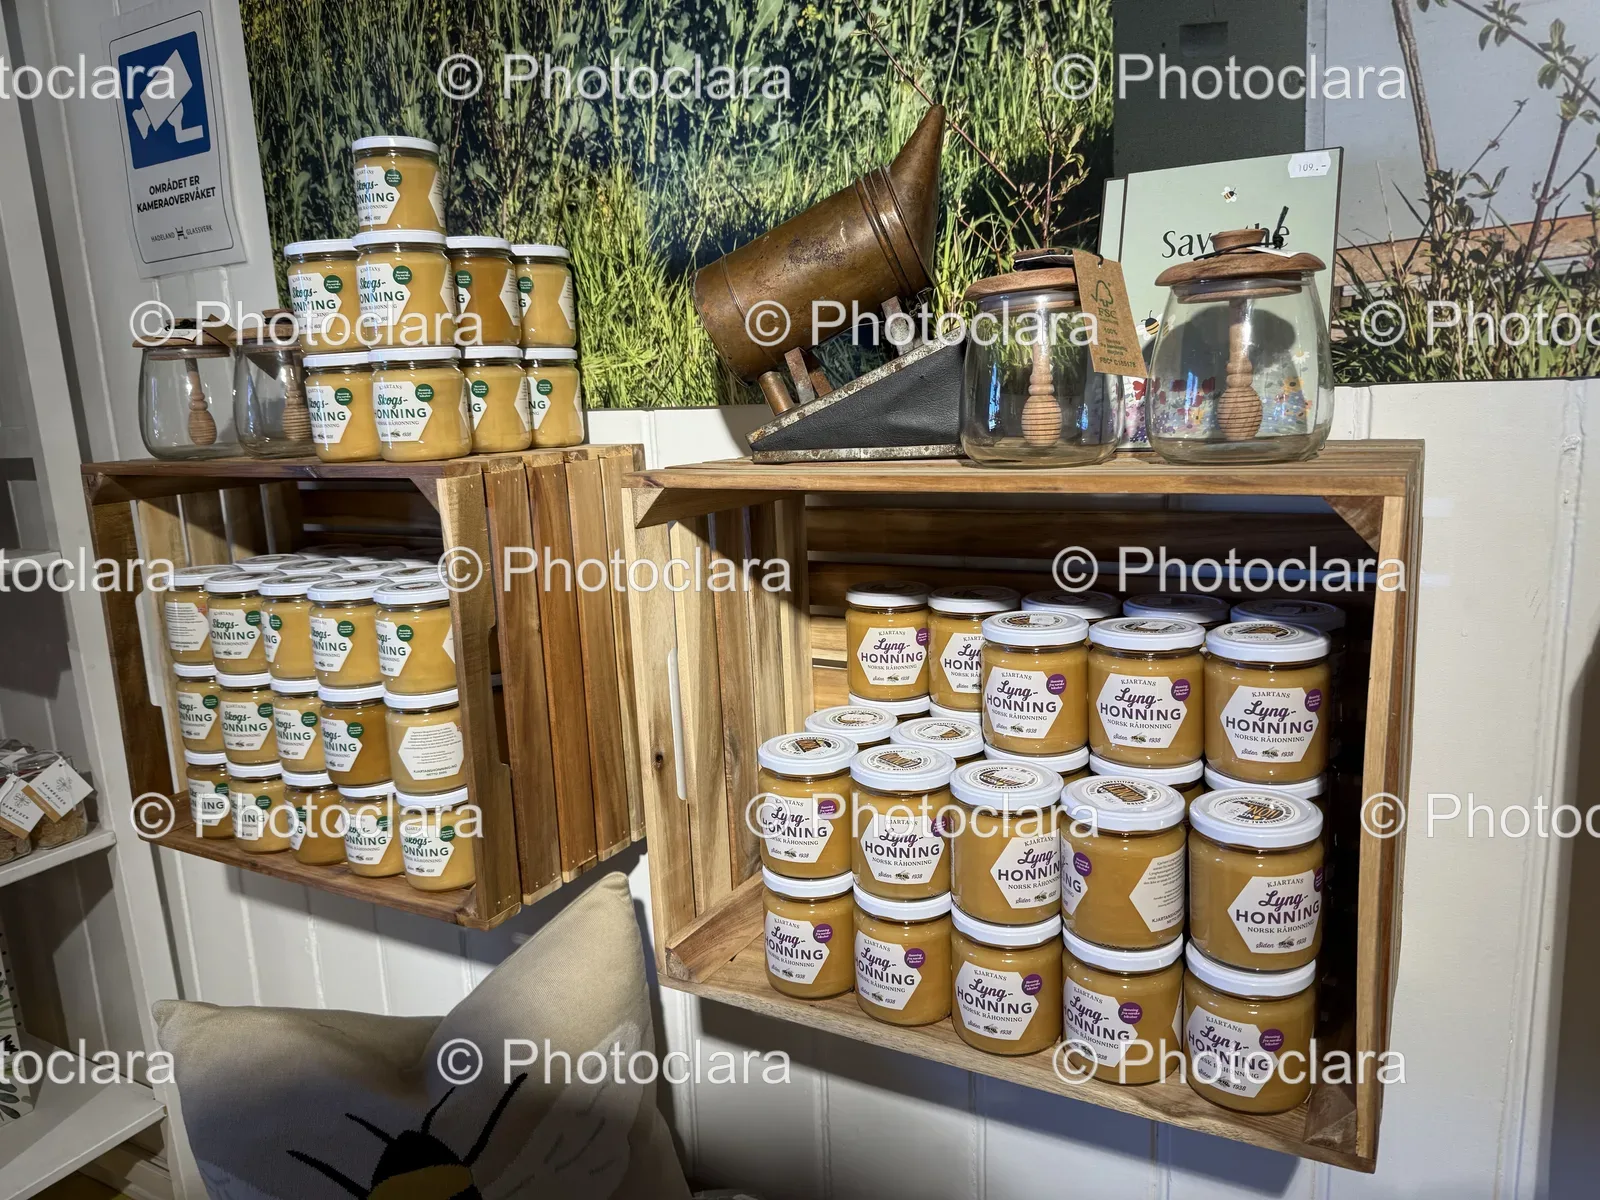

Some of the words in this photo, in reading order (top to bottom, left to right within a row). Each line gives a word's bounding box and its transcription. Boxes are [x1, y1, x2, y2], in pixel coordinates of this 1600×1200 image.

[149, 178, 187, 195] OMRÅDET
[189, 175, 200, 186] ER
[136, 186, 216, 213] KAMERAOVERVÅKET
[356, 192, 395, 205] ONNING
[150, 231, 175, 242] HADELAND
[185, 224, 213, 236] GLASSVERK
[1162, 230, 1212, 258] Sav
[1245, 223, 1290, 248] he
[360, 291, 405, 304] ONNING
[293, 299, 336, 312] ONNING
[1098, 307, 1117, 319] FSC
[377, 393, 408, 409] Skogs-
[311, 411, 346, 421] NNING
[212, 618, 239, 632] Skogs-
[211, 630, 256, 640] ONNING
[314, 642, 347, 652] NNING
[873, 637, 911, 654] Lyng-
[861, 651, 923, 664] HONNING
[885, 663, 918, 671] RÅHONNING
[944, 658, 981, 671] HONN
[1001, 672, 1033, 680] KJARTANS
[1120, 679, 1157, 687] KJARTANS
[997, 680, 1038, 701] Lyng-
[1251, 691, 1291, 699] KJARTANS
[986, 693, 1057, 713] HONNING
[1114, 687, 1163, 710] Lyng-
[224, 711, 252, 724] Skogs-
[992, 708, 1008, 719] NORSK
[1009, 713, 1048, 721] RÅHONNING
[1100, 702, 1181, 721] HONNING
[1243, 700, 1297, 722] Lyng-
[223, 722, 268, 733] ONNING
[1107, 718, 1128, 728] NORSK
[1129, 721, 1172, 729] RÅHONNING
[1225, 716, 1314, 735] HONNING
[278, 731, 312, 741] NNING
[1234, 733, 1259, 742] NORSK
[1260, 735, 1305, 743] RÅHONNING
[325, 742, 357, 752] NNING
[345, 836, 387, 845] ONNING
[782, 838, 819, 846] RÅHONNING
[865, 840, 940, 859] HONNING
[872, 857, 893, 866] NORSK
[893, 859, 933, 867] RÅHONNING
[1017, 848, 1058, 869] Lyng-
[998, 860, 1060, 882] HONNIN
[1267, 878, 1304, 888] KJARTANS
[1258, 890, 1309, 912] Lyng-
[1235, 900, 1319, 925] HONNING
[774, 917, 800, 929] KJARTANS
[1247, 926, 1275, 934] NORSK
[1276, 919, 1315, 933] RÅHONNING
[771, 926, 806, 948] Lyng-
[863, 938, 891, 952] KJARTANS
[781, 956, 815, 968] RÅHONNING
[861, 947, 897, 971] Lyng-
[973, 969, 1007, 981] KJARTANS
[870, 980, 906, 993] RÅHONNING
[968, 978, 1014, 1003] Lyng-
[957, 986, 1032, 1015] HONNING
[1073, 986, 1103, 1005] KJARTANS
[1069, 995, 1110, 1025] Lyng-
[982, 1013, 1023, 1023] RÅHONNING
[1205, 1016, 1243, 1034] KJARTANS
[1188, 1030, 1269, 1072] HONNING
[1232, 1083, 1247, 1092] 1938
